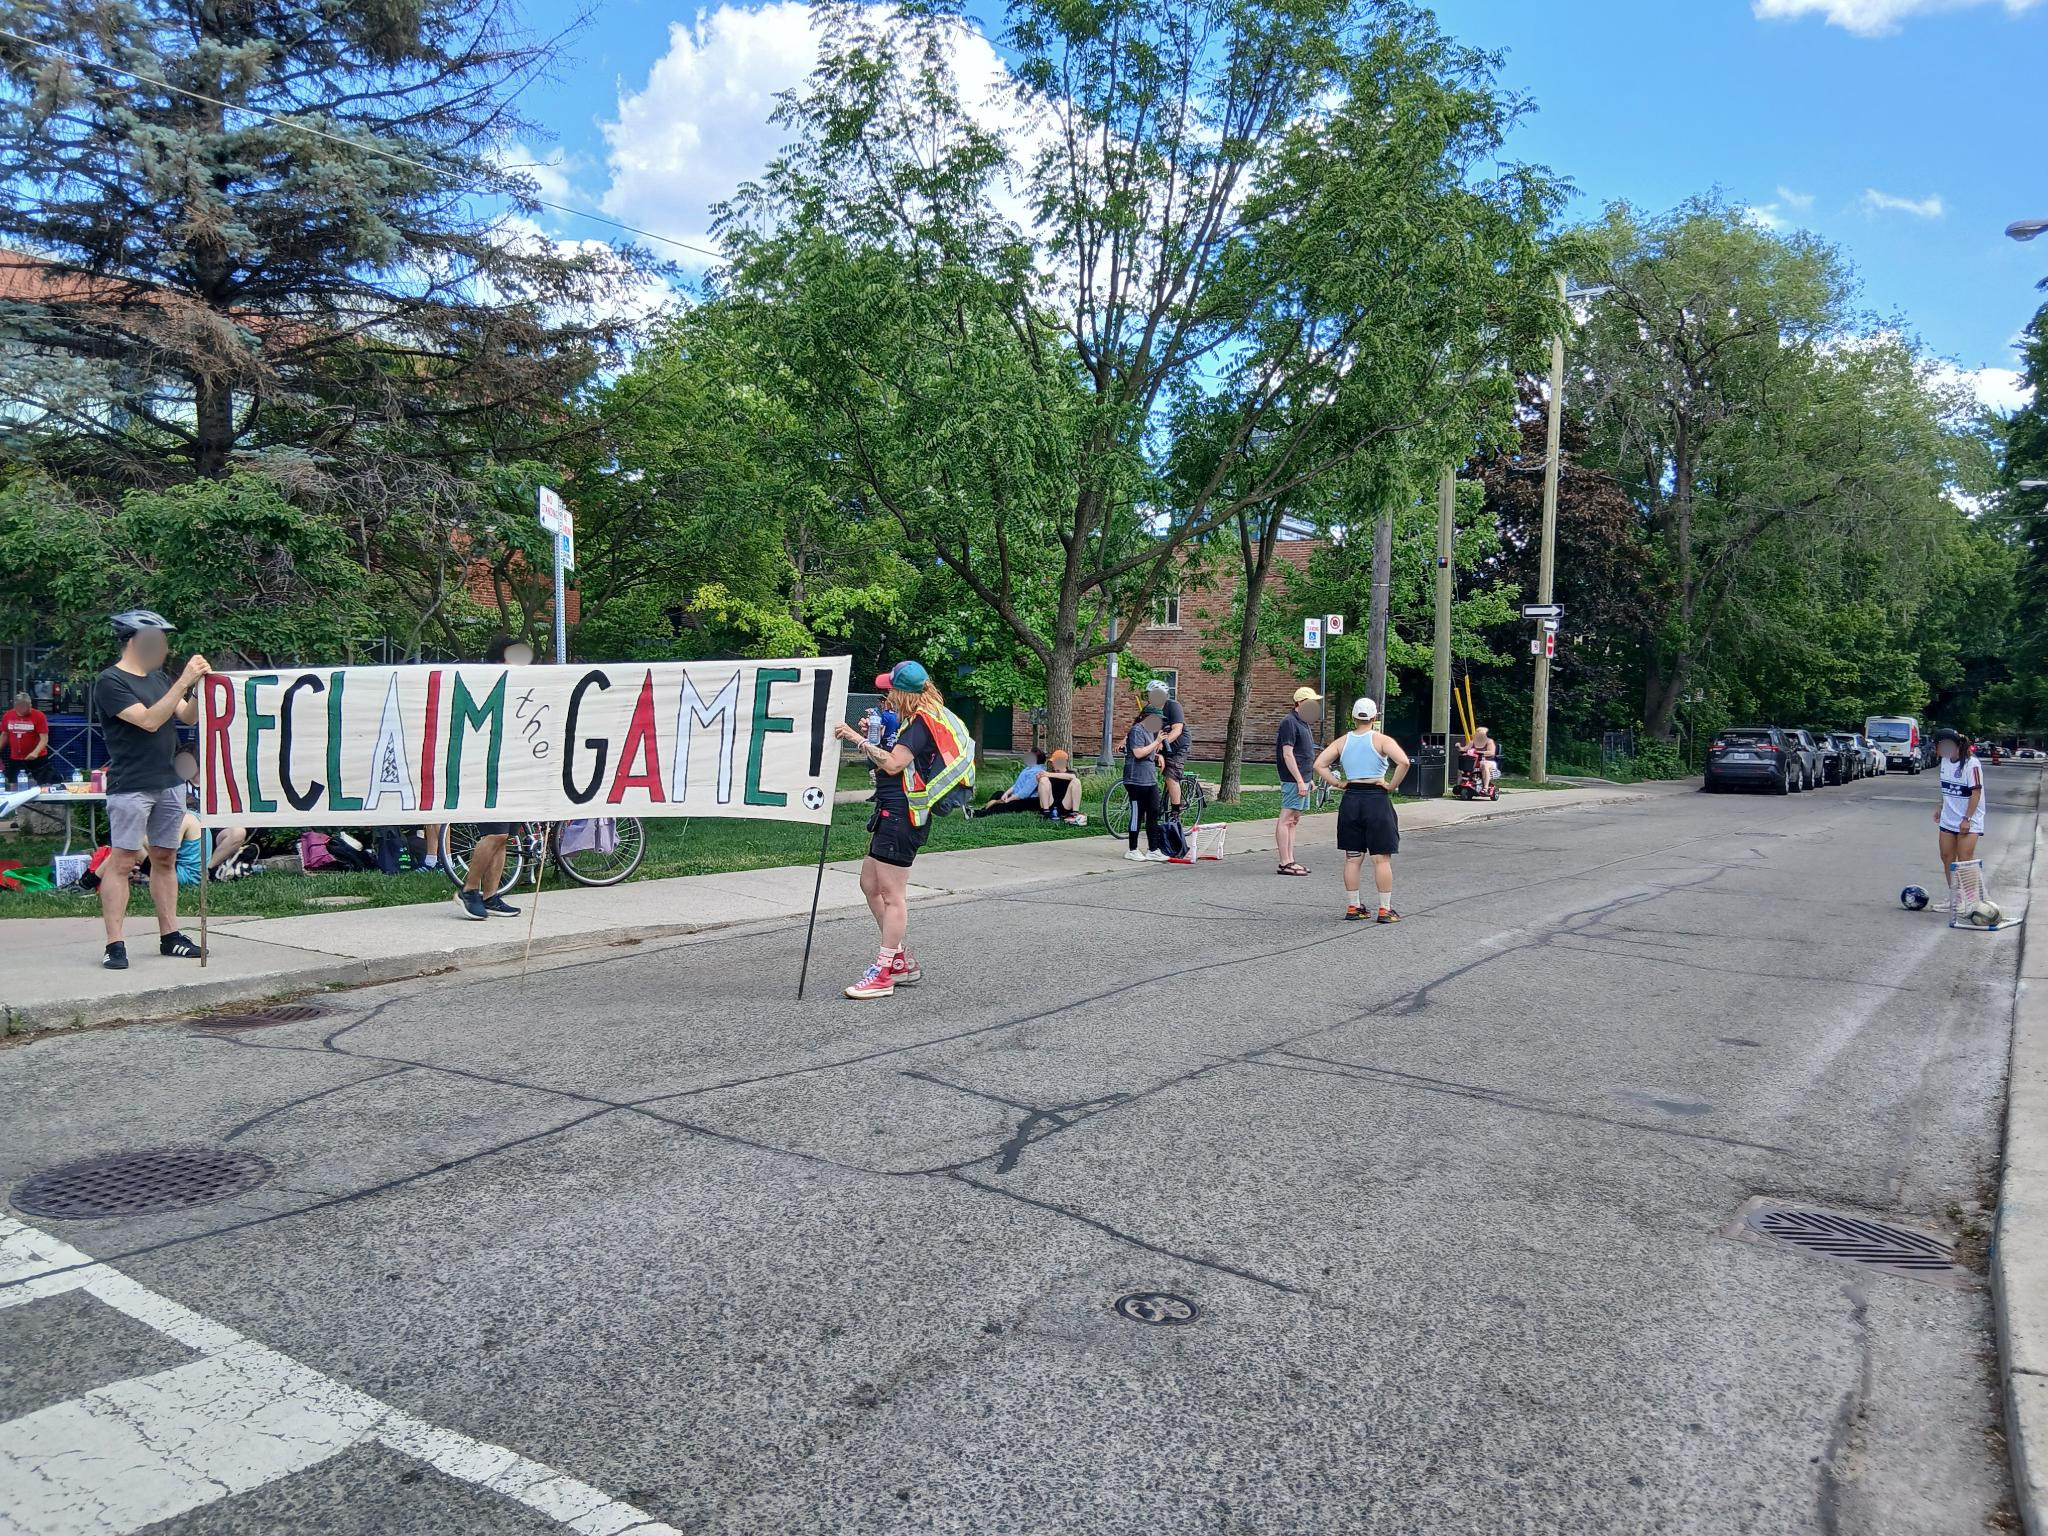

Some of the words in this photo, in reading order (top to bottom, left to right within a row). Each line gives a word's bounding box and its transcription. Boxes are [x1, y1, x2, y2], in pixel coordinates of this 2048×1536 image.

[204, 670, 508, 814] RECLAIM
[515, 687, 549, 759] the
[562, 667, 833, 811] GAME!
